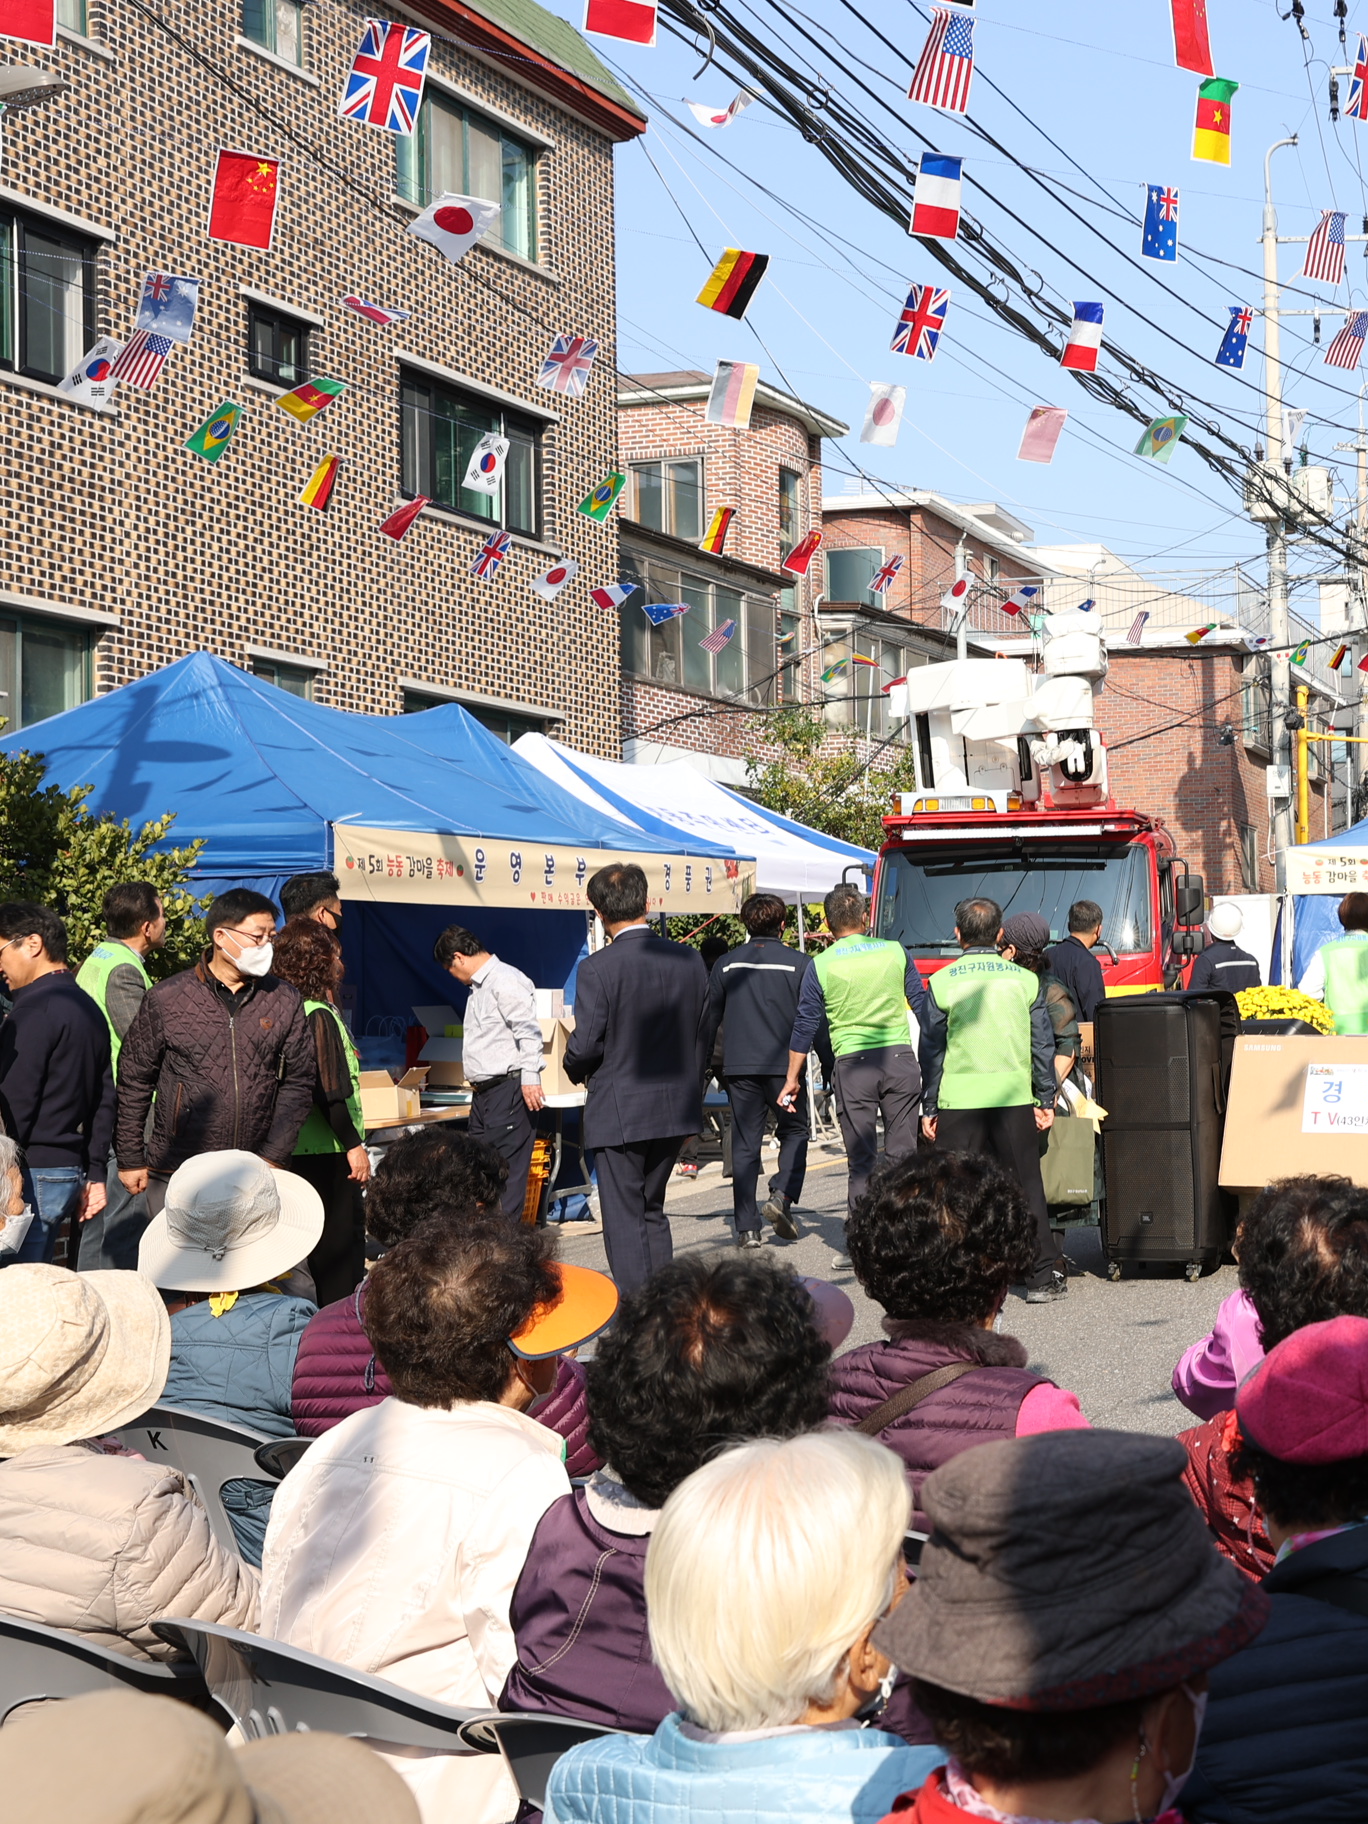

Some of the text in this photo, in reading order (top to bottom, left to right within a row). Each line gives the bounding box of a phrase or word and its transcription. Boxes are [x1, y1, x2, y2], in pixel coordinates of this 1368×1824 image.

[357, 854, 454, 880] 제 5회 능동 감마을 축제
[1302, 871, 1322, 884] 능동
[1243, 1044, 1282, 1052] SAMSUNG
[147, 1429, 168, 1451] K
